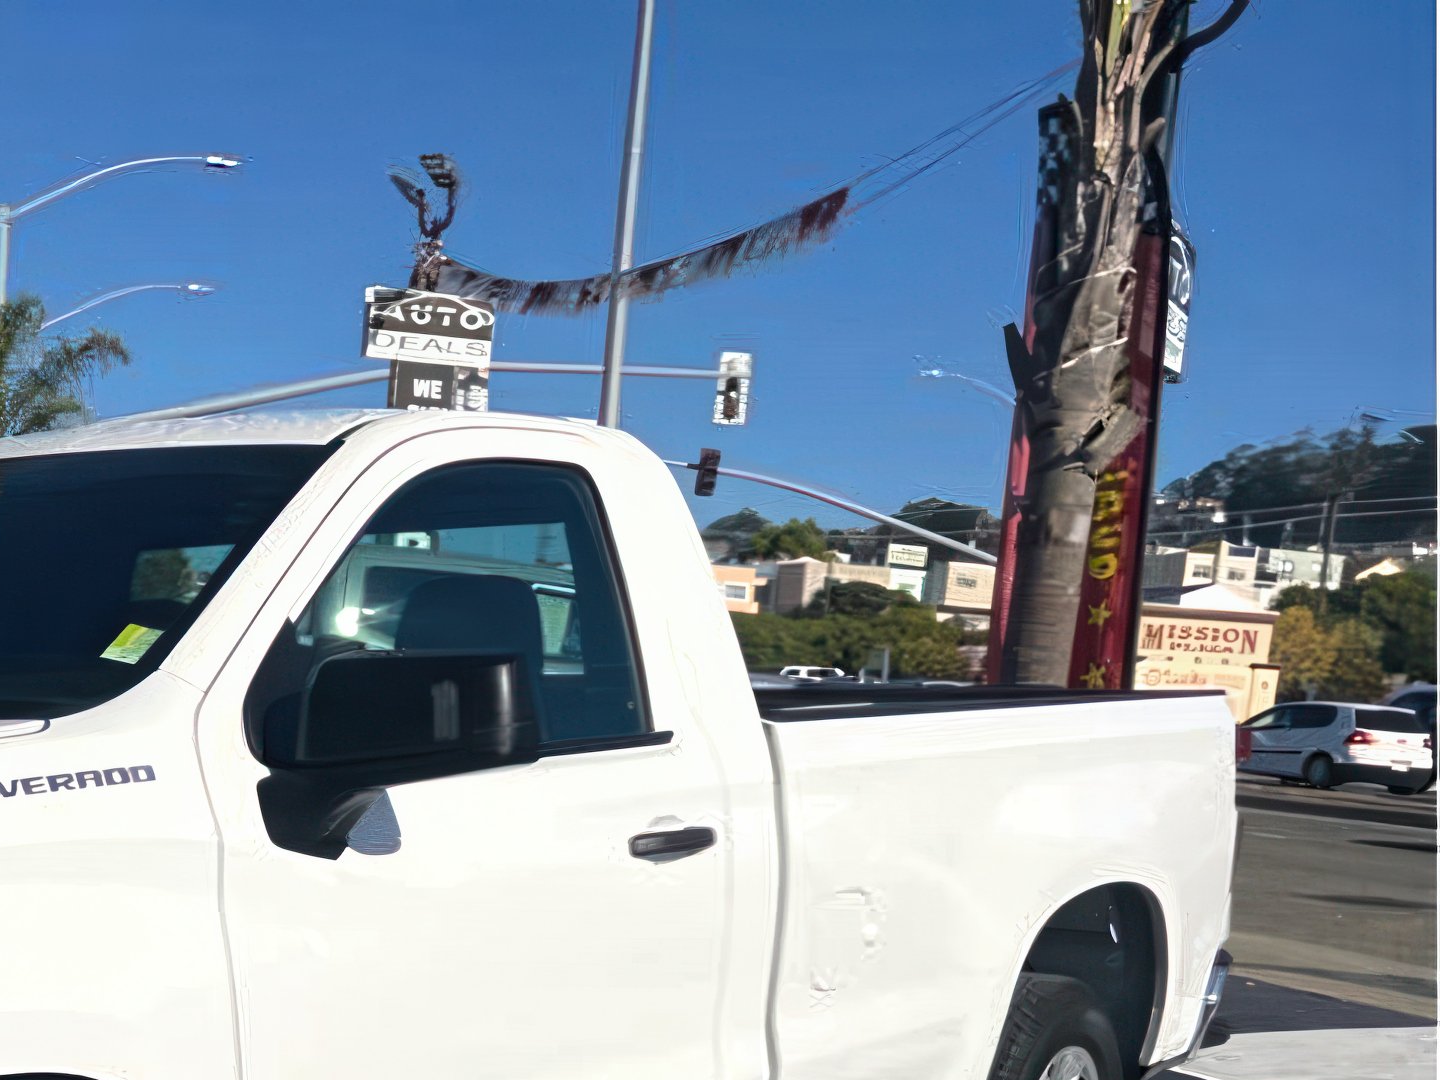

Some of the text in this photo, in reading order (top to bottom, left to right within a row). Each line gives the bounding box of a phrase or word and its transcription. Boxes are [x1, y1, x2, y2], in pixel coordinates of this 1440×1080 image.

[371, 304, 485, 331] AUTO
[372, 333, 488, 356] DEALS
[413, 378, 442, 400] WE
